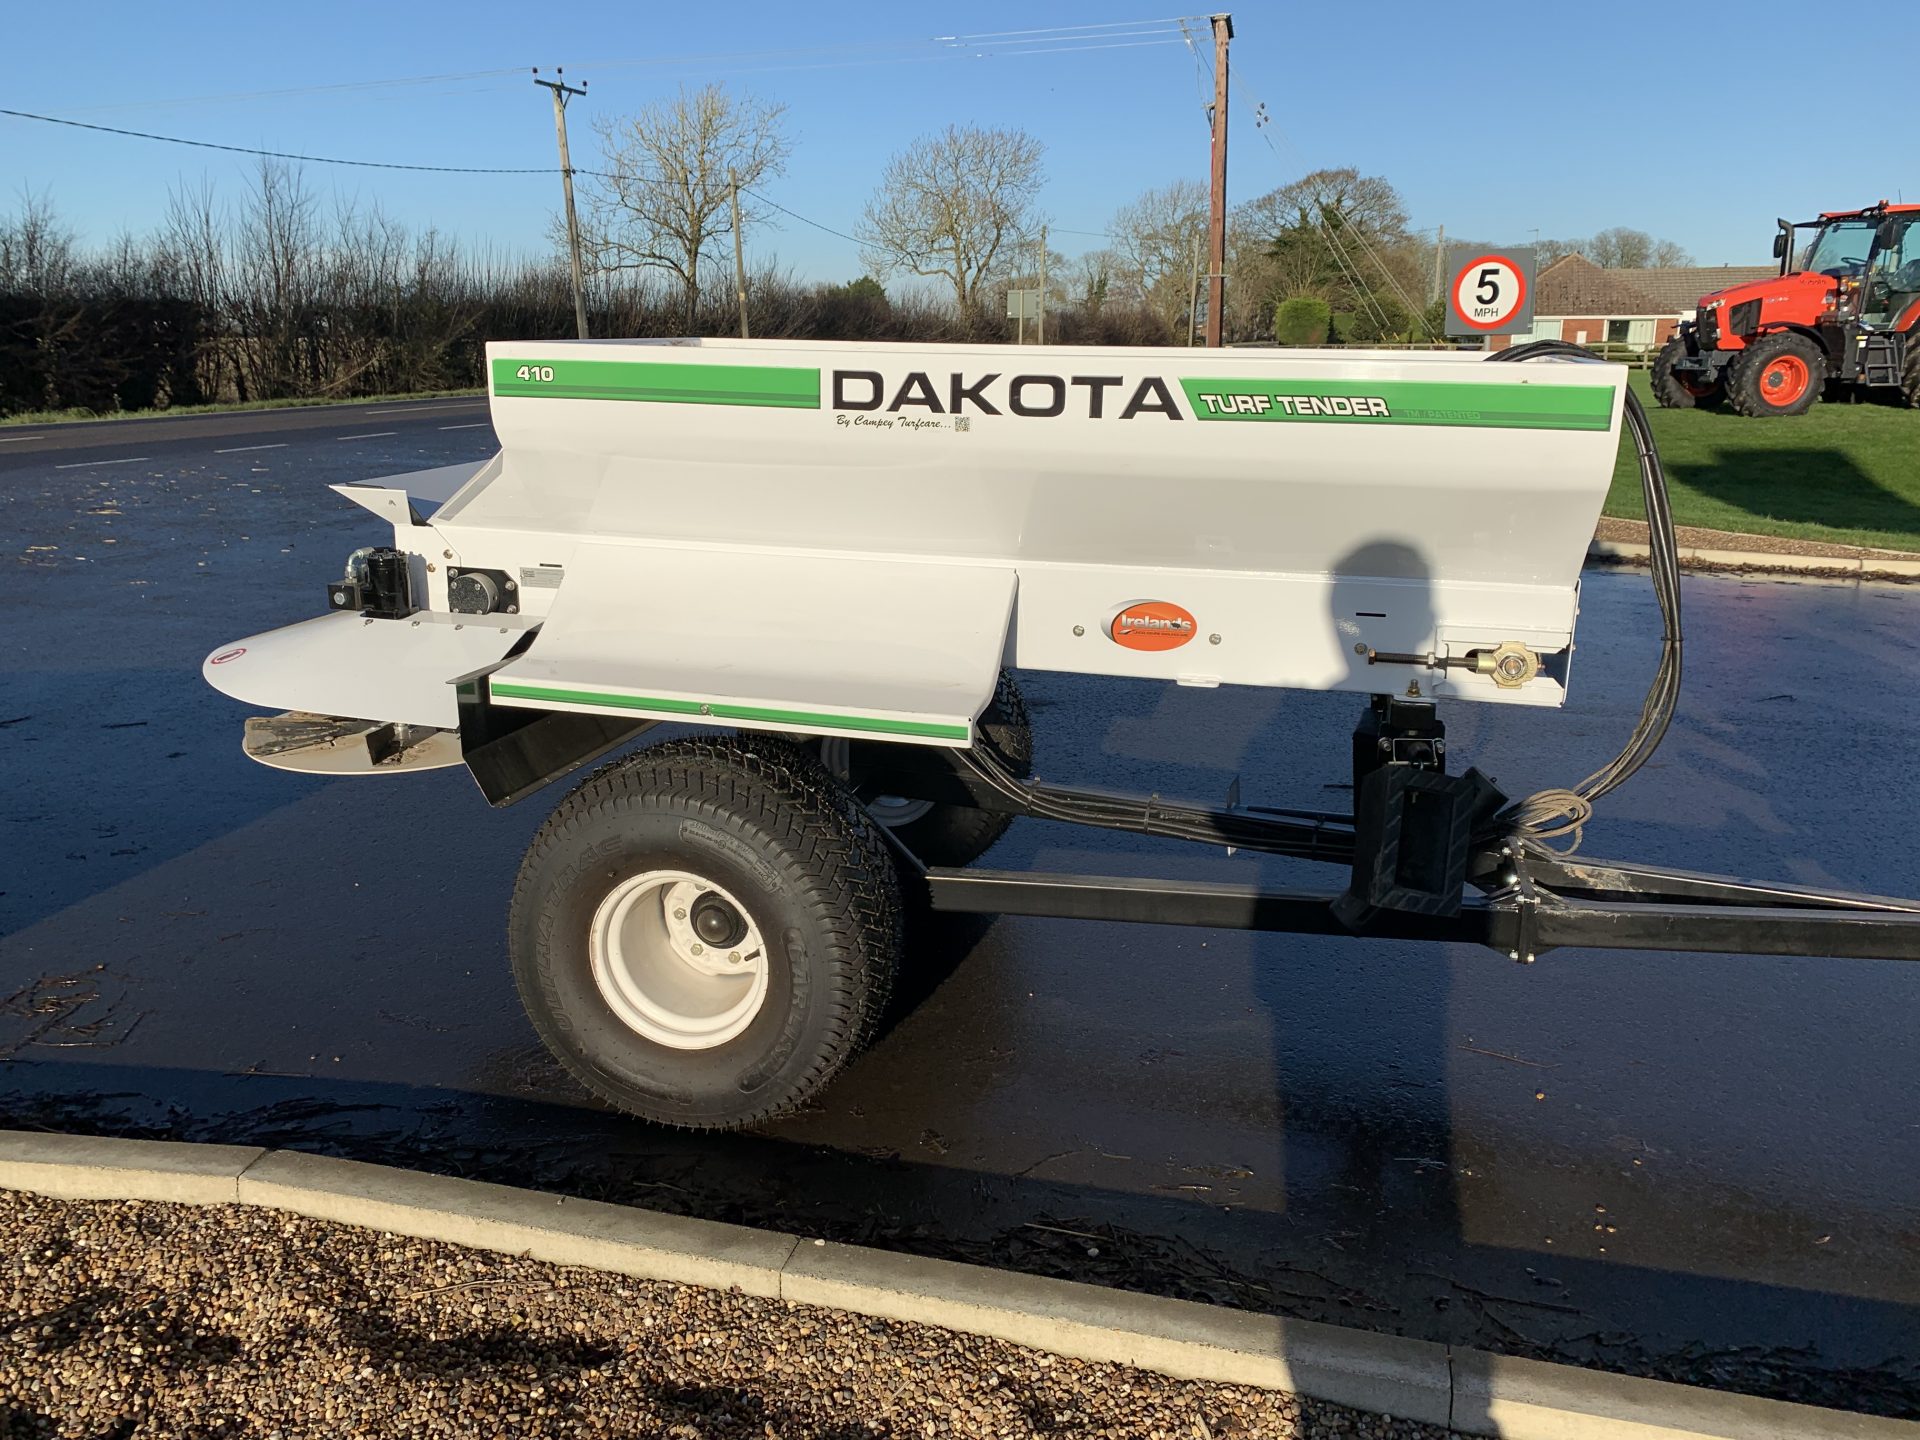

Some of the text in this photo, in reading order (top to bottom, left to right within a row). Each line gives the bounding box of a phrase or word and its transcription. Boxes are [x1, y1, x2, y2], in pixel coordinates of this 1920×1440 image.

[1476, 269, 1500, 305] 5
[1474, 308, 1499, 317] MPH
[516, 365, 554, 382] 410
[832, 369, 1184, 421] DAKOTA
[1198, 394, 1391, 417] TURF TENDER
[836, 415, 850, 427] By
[854, 415, 893, 429] Campey
[1428, 410, 1480, 420] PATENTED
[1121, 614, 1191, 630] Irelands
